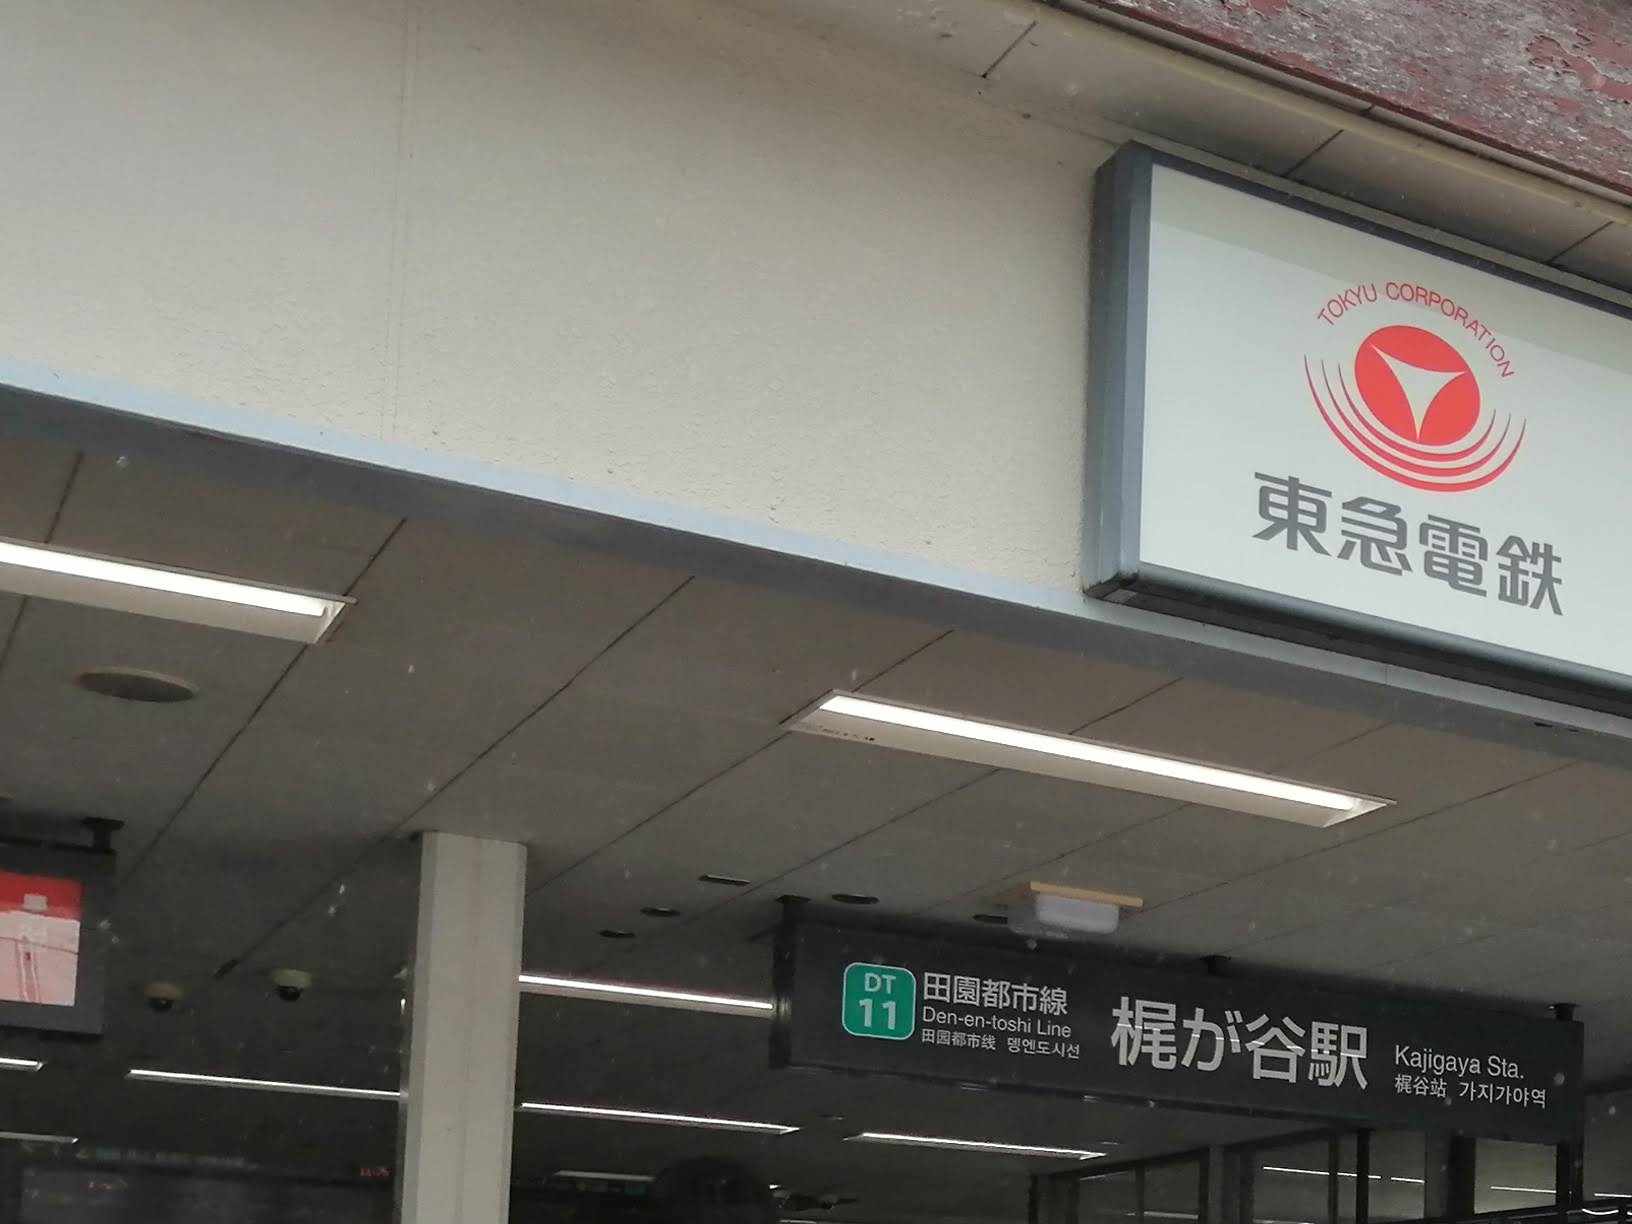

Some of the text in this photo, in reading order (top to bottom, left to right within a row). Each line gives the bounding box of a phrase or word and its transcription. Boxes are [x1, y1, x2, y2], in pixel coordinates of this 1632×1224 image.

[1316, 282, 1515, 378] TOKYU CORPORATION
[1252, 471, 1564, 617] 東急電鉄
[864, 972, 897, 994] DT
[922, 971, 1068, 1016] 田園都市線
[858, 998, 897, 1031] 11
[922, 1006, 1072, 1038] Den-en-toshi Line
[1110, 996, 1369, 1090] 梶が谷駅
[1394, 1044, 1525, 1080] Kajigaya Sta.
[1394, 1073, 1547, 1109] 梶谷站 가지가야역
